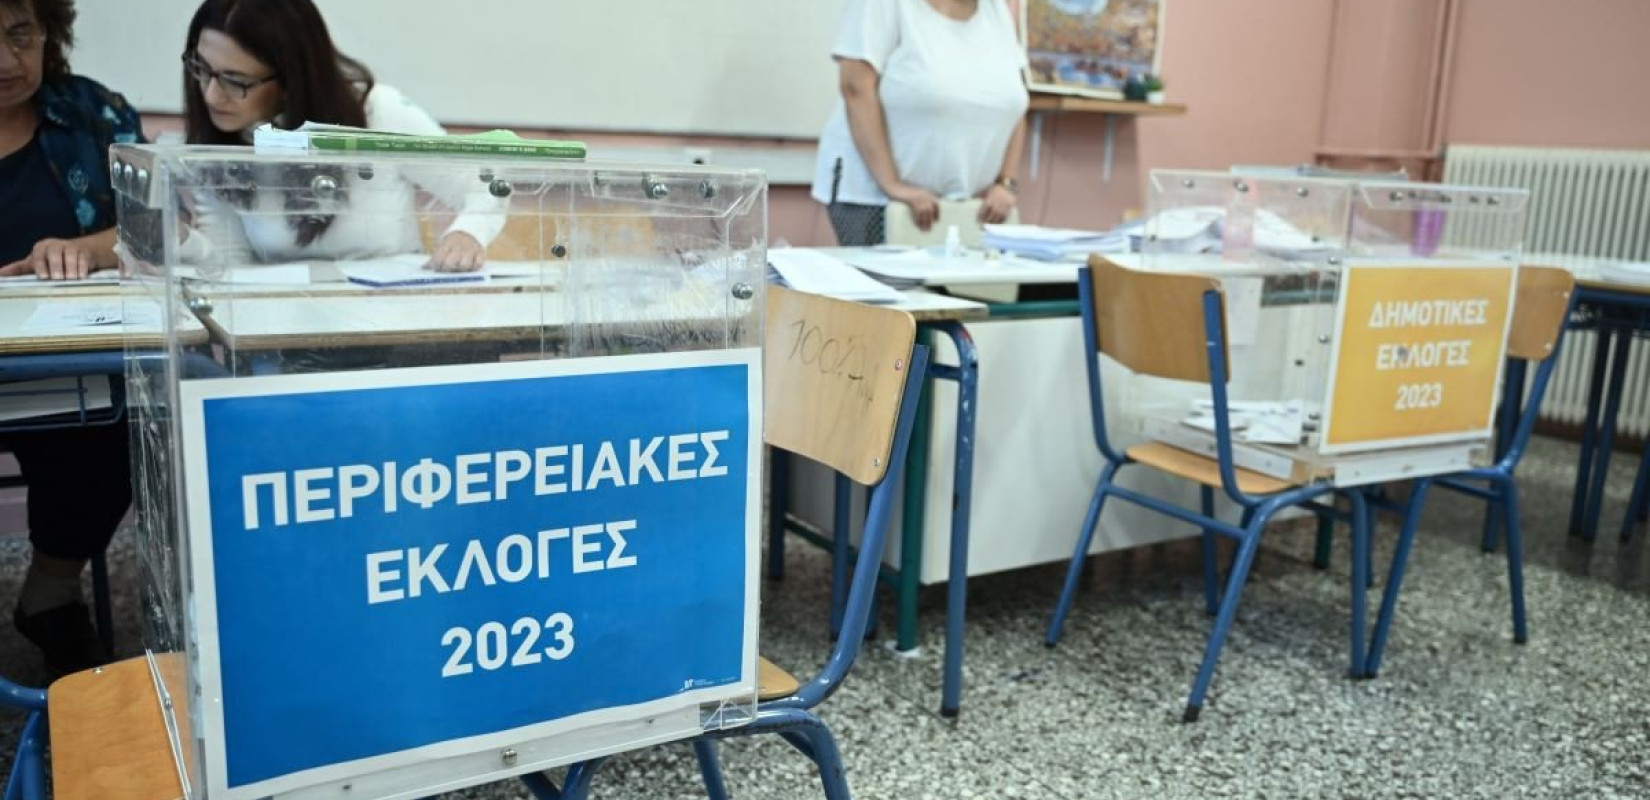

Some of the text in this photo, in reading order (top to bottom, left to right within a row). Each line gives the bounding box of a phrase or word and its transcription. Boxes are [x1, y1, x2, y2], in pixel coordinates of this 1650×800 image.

[1368, 299, 1488, 328] ΔΗΜΟΤΙΚΕΣ
[1376, 340, 1471, 369] ΕΚΛΟΓΕΣ
[1395, 383, 1442, 410] 2023
[241, 429, 729, 530] ΠΕΡΙΦΕΡΕΙΑΚΕΣ
[366, 519, 638, 604] ΕΚΛΟΓΕΣ
[441, 612, 575, 677] 2023
